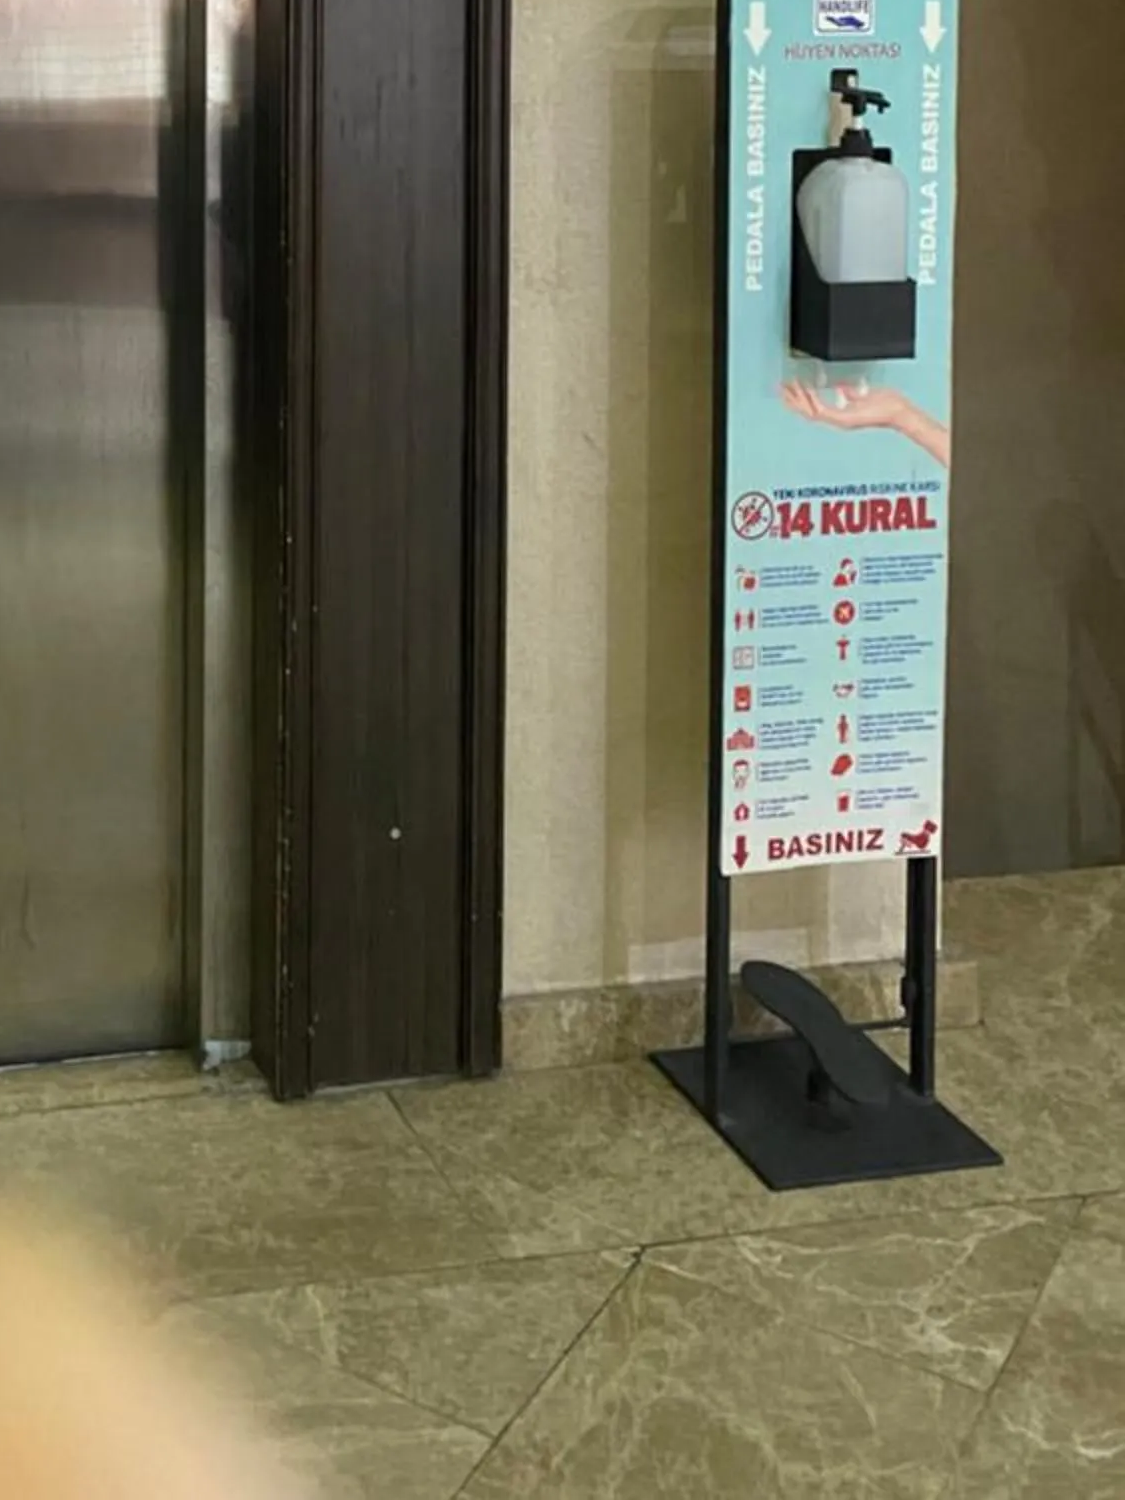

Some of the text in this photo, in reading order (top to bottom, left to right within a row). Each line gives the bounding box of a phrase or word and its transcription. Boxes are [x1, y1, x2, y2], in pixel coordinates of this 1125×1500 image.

[745, 64, 767, 292] PEDALA BASINIZ
[918, 63, 941, 286] PEDALA BASINIZ
[776, 496, 937, 539] 14 KURAL
[767, 828, 885, 861] BASINIZ
